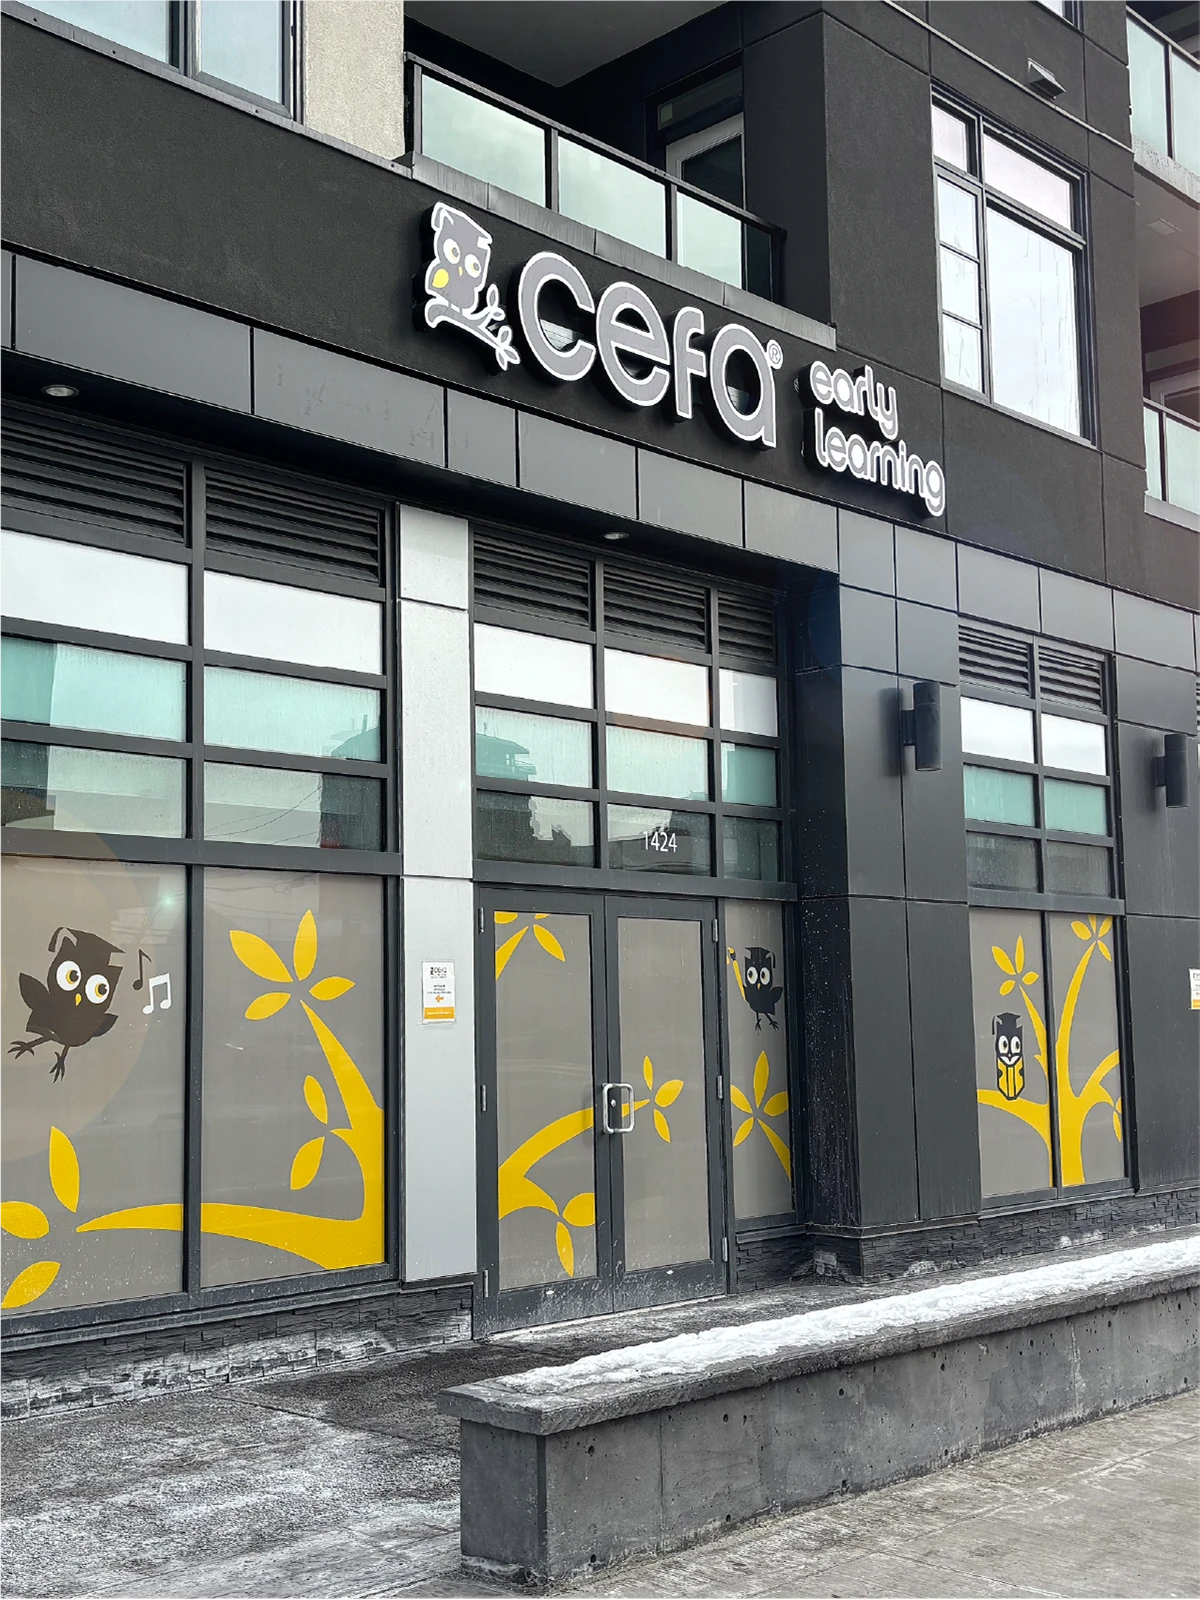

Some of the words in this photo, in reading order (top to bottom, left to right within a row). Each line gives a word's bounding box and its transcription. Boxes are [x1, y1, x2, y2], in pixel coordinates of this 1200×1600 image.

[809, 360, 899, 440] early
[814, 408, 946, 517] learning
[643, 831, 678, 853] 1424
